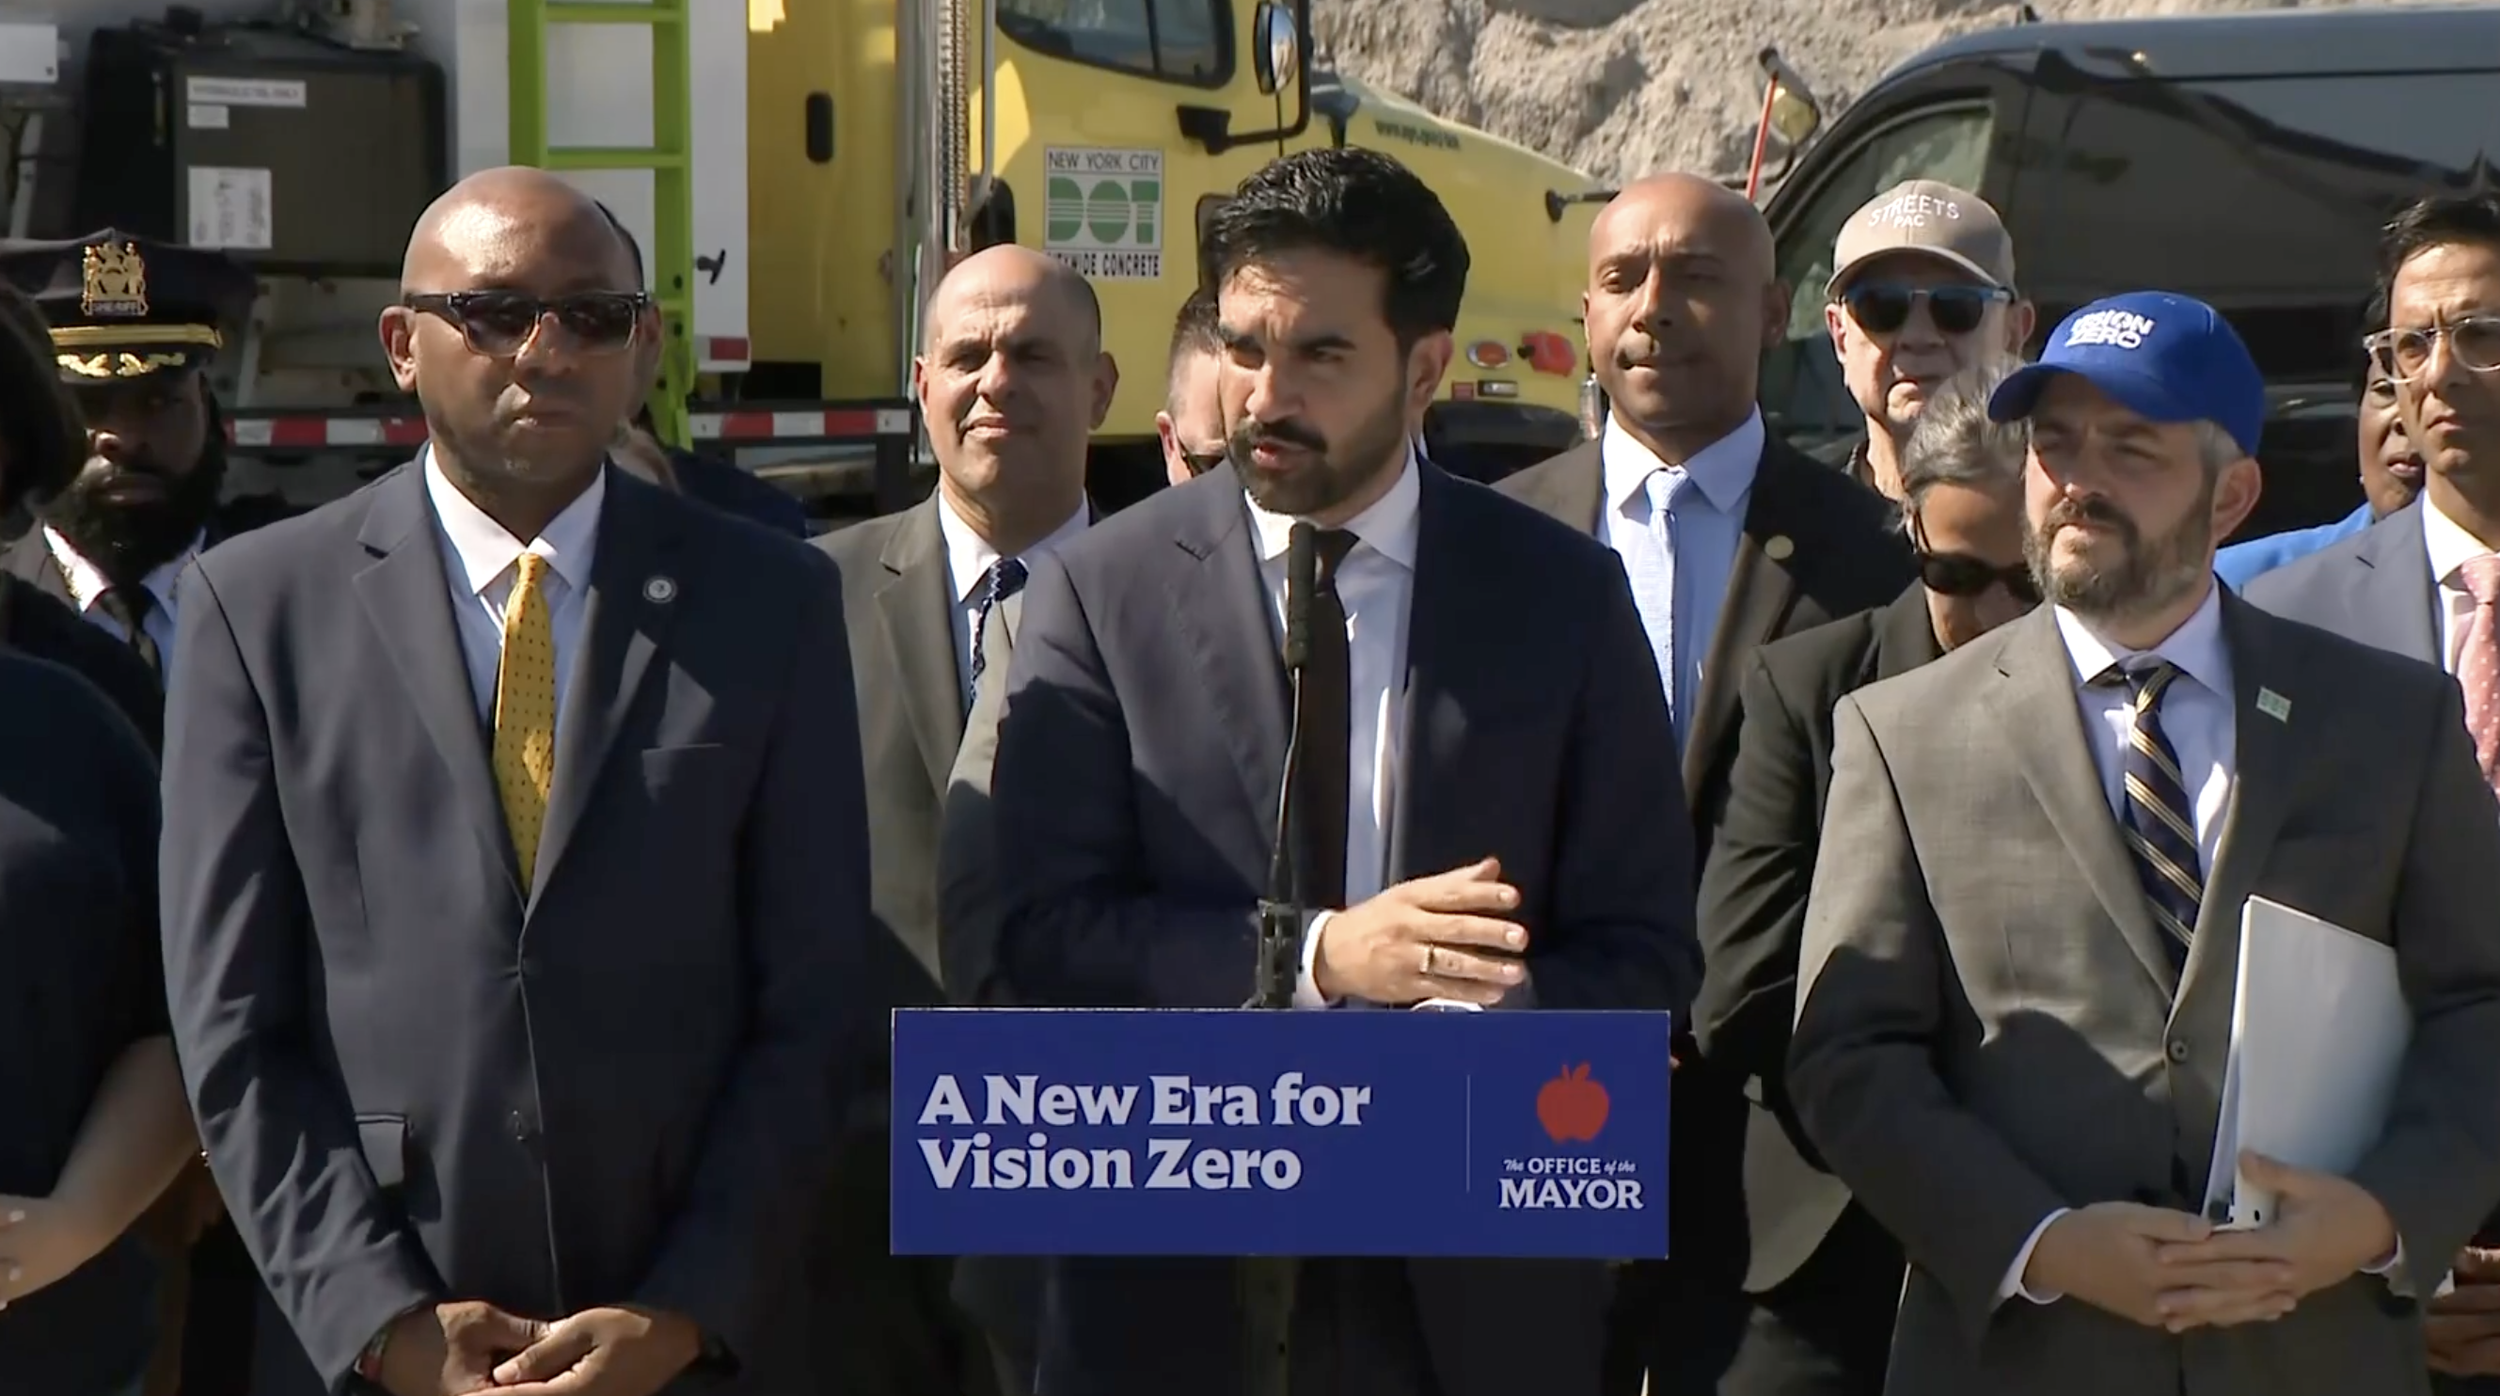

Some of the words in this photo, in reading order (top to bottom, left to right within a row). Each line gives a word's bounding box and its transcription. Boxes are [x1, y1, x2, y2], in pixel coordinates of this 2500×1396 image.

[1048, 151, 1079, 168] NEW
[1086, 152, 1122, 170] YORK
[1129, 153, 1159, 170] CITY
[1048, 176, 1160, 244] DOT
[1868, 193, 1960, 228] STREETS
[1893, 214, 1925, 229] PAC
[1103, 253, 1159, 276] CONCRETE
[2064, 326, 2141, 349] ZERO
[918, 1075, 974, 1125] A
[983, 1075, 1139, 1125] New
[1149, 1075, 1260, 1126] Era
[1271, 1072, 1371, 1126] for
[917, 1132, 1134, 1190] Vision
[1144, 1138, 1301, 1190] Zero
[1503, 1159, 1524, 1172] The
[1527, 1157, 1601, 1174] OFFICE
[1604, 1159, 1617, 1176] of
[1618, 1160, 1636, 1173] the
[1499, 1177, 1644, 1209] MAYOR
